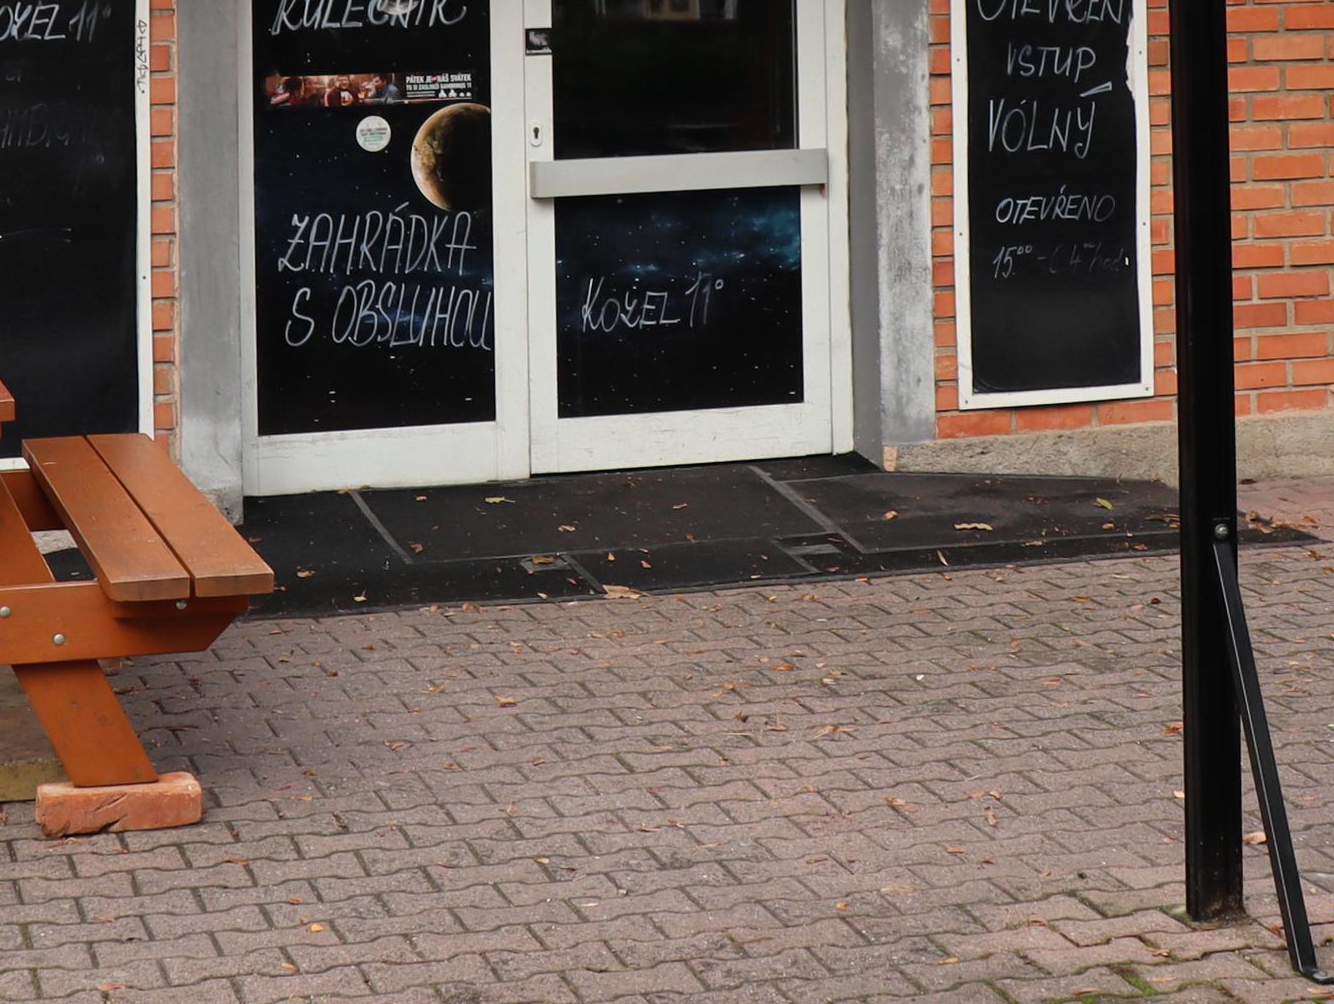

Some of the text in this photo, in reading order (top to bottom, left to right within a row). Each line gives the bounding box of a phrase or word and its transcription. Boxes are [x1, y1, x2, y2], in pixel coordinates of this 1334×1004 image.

[1007, 42, 1097, 83] VSTUP
[278, 201, 477, 276] ZAHRÁDKA
[285, 279, 492, 351] S OBSLUHOU
